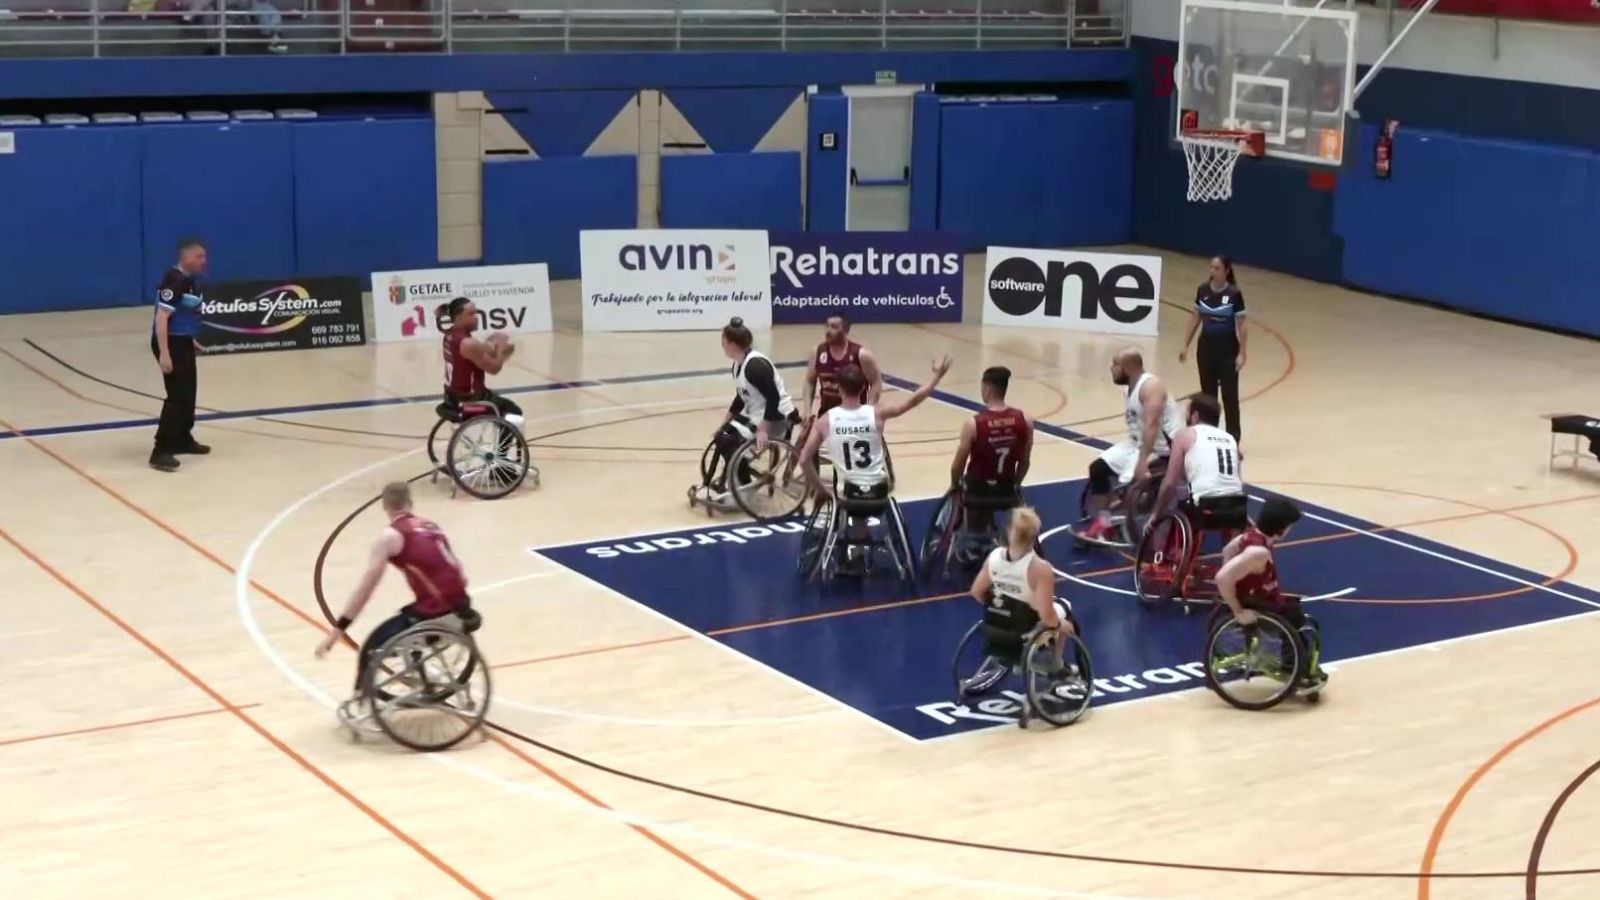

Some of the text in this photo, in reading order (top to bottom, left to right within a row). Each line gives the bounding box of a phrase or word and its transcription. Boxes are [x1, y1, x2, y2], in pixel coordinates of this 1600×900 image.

[619, 244, 713, 271] avin
[769, 246, 959, 288] Rehatrans
[409, 283, 452, 295] GETAFE
[990, 279, 1045, 292] software
[646, 294, 663, 306] por
[666, 292, 675, 301] la
[772, 294, 934, 308] Adaptación de vehículos
[311, 325, 327, 335] 669
[842, 439, 871, 471] 13
[995, 447, 1010, 474] 7
[1217, 447, 1233, 476] 11
